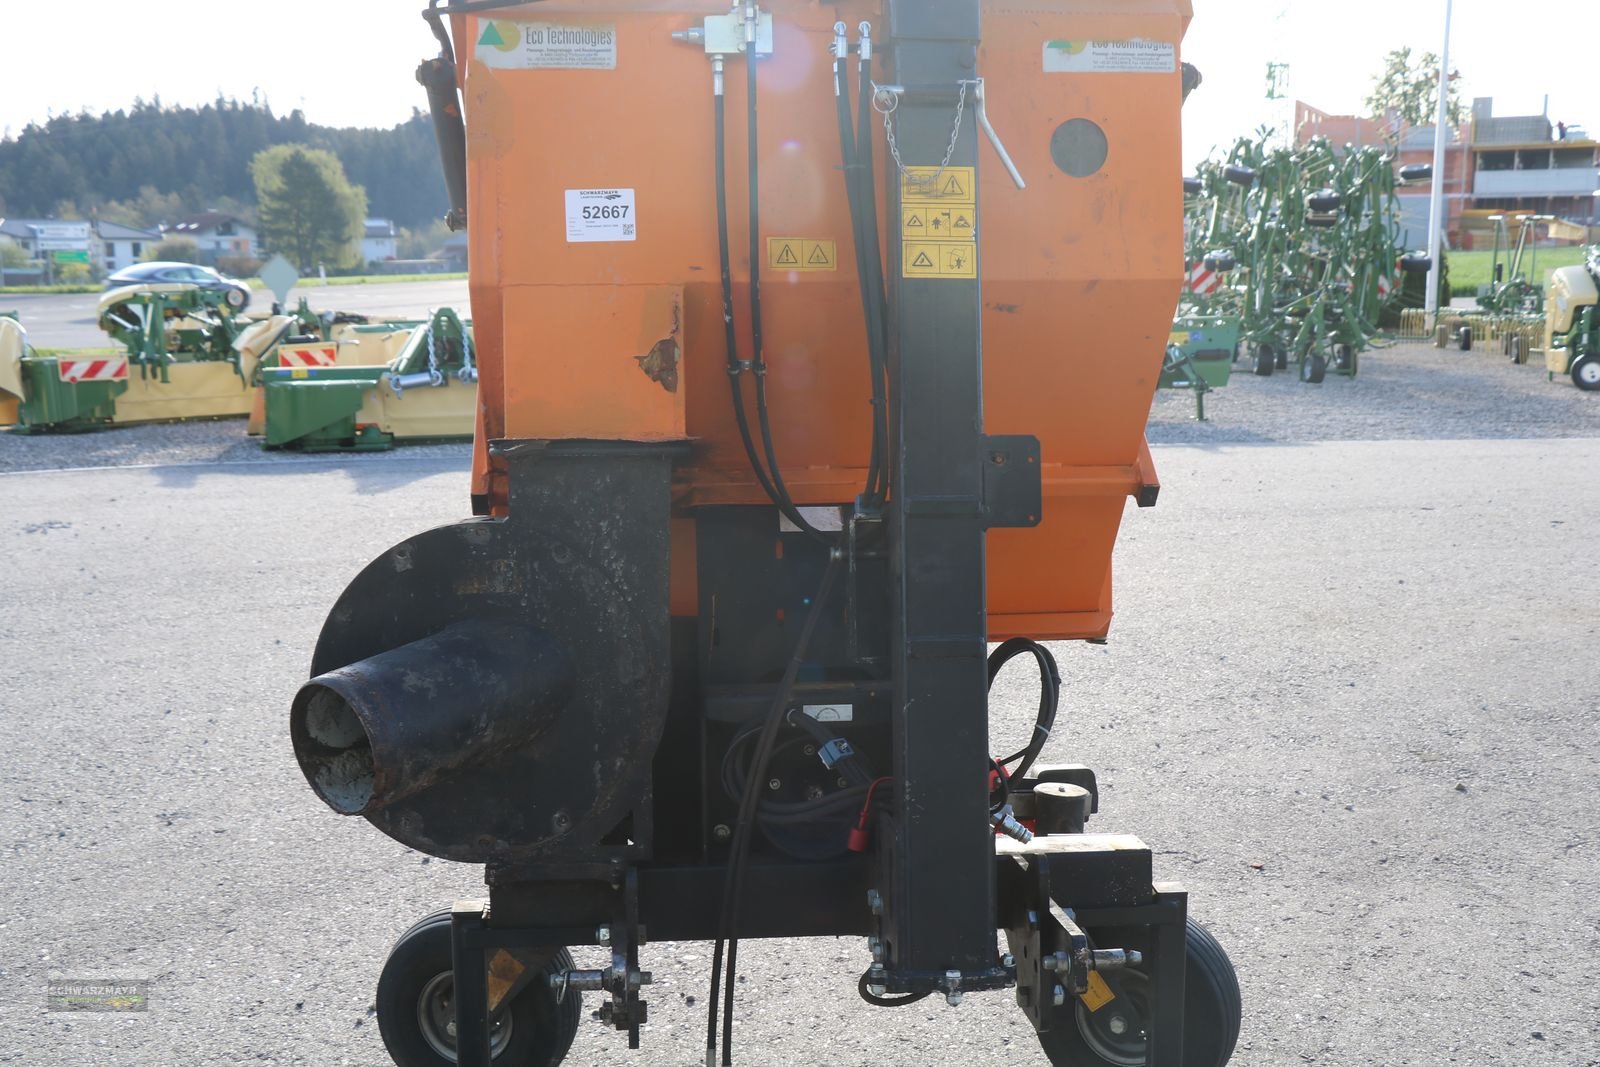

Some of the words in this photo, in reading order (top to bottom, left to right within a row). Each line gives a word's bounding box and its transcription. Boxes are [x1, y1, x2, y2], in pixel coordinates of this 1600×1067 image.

[526, 27, 543, 45] Eco
[546, 27, 612, 47] Technologies
[582, 205, 629, 219] 52667
